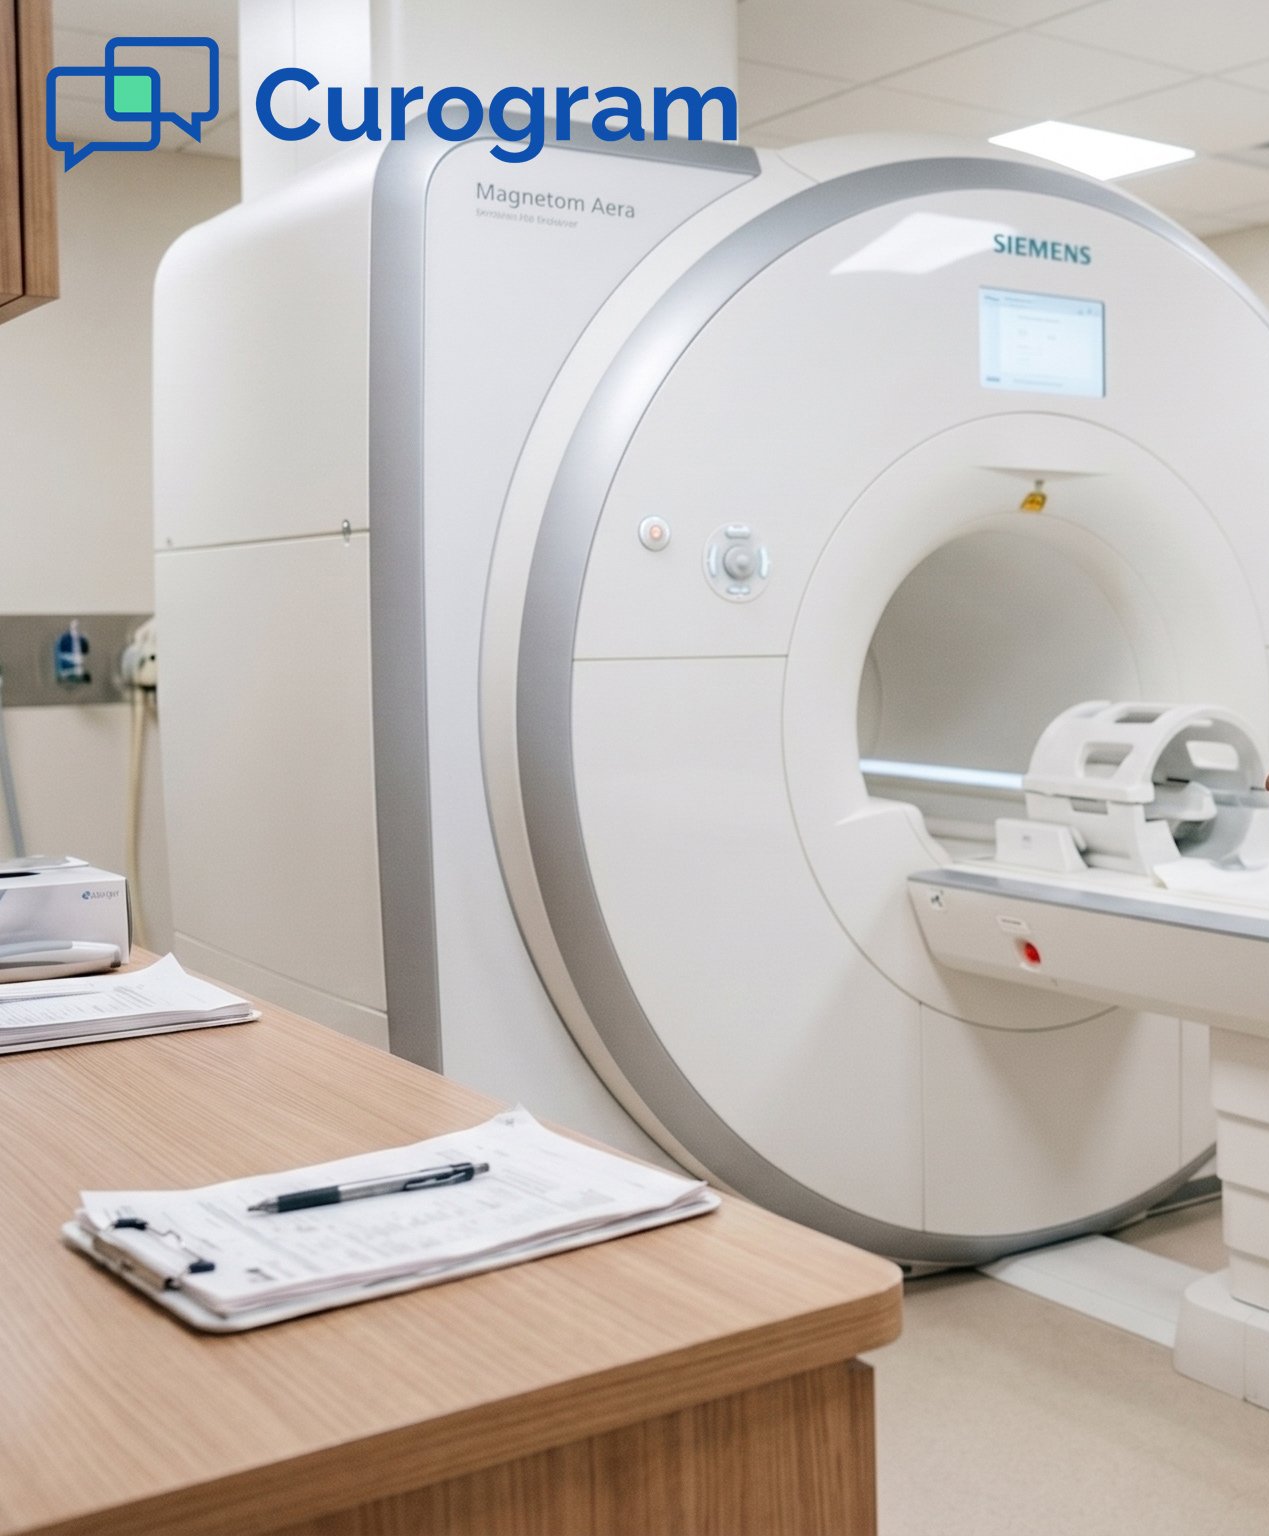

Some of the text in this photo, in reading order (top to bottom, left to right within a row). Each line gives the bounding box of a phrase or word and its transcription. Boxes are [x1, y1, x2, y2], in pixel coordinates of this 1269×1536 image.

[475, 182, 585, 213] Magnetom
[591, 197, 636, 219] Aera
[993, 233, 1092, 266] SIEMENS
